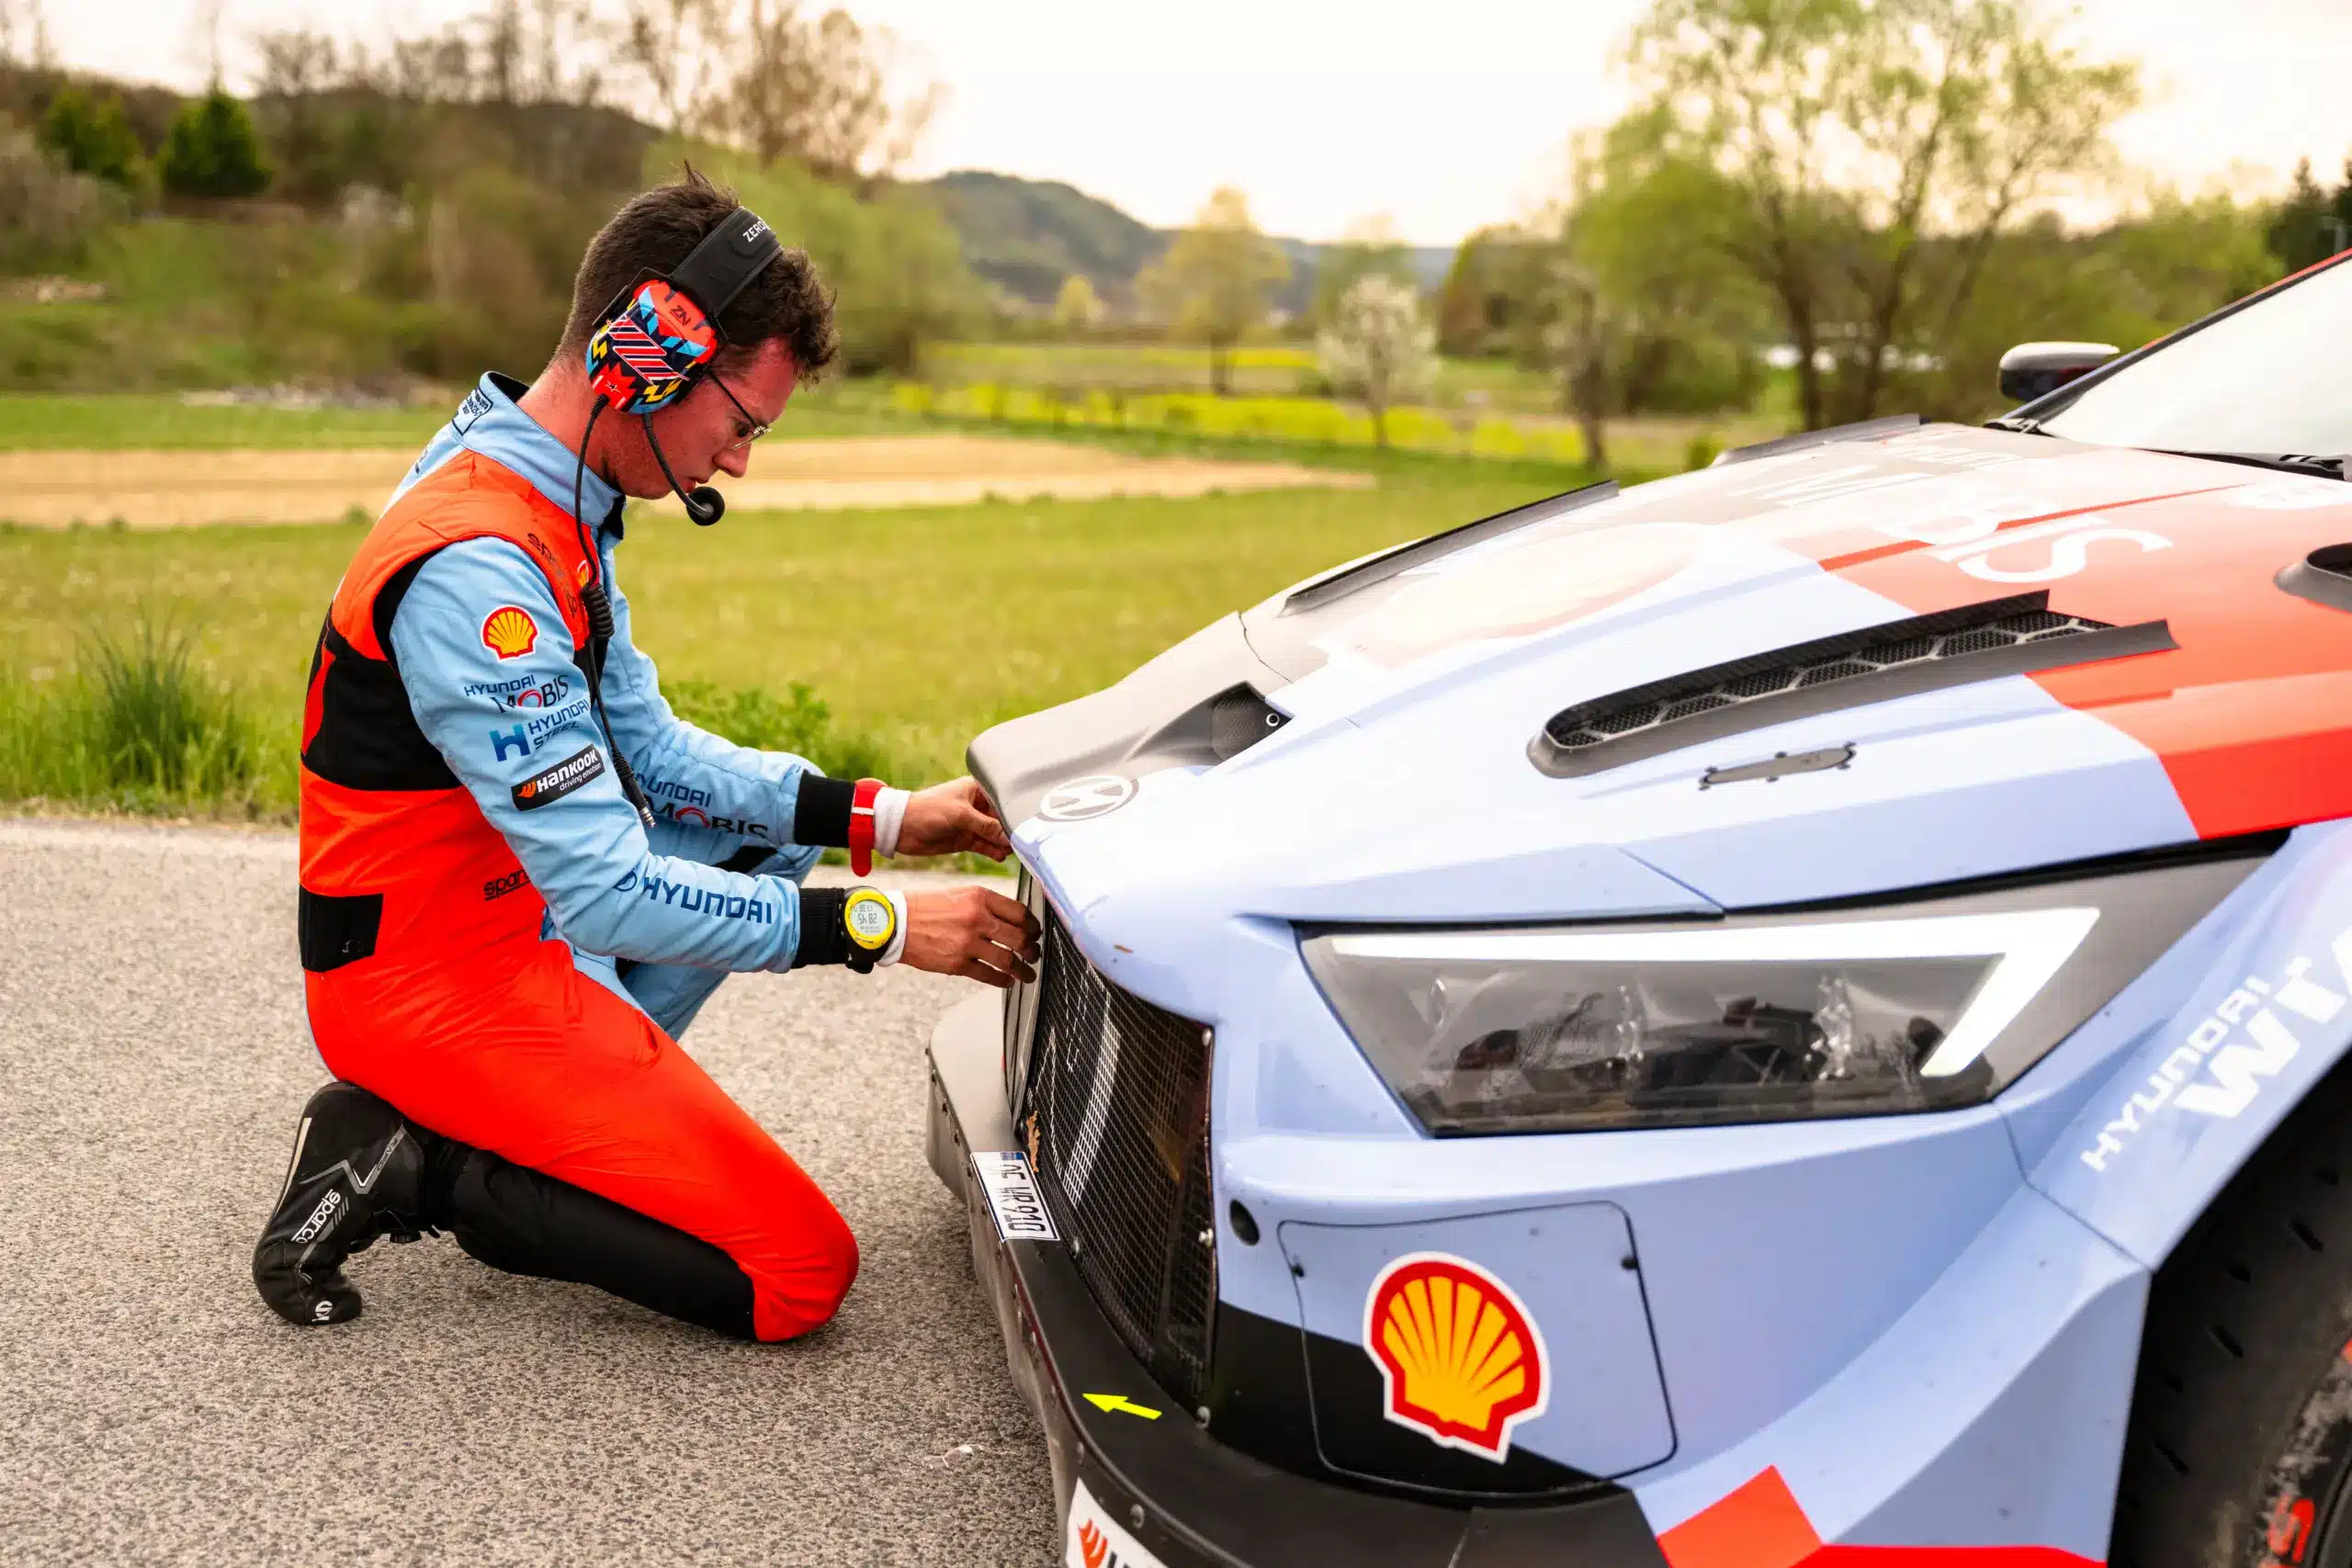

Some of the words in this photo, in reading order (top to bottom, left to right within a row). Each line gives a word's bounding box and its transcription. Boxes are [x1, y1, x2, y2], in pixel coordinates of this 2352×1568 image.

[742, 220, 768, 243] ZERO
[464, 674, 537, 697] HYUNDAI
[528, 699, 589, 735] HYUNDAI
[533, 720, 582, 750] STEEL
[560, 773, 583, 791] driving
[582, 763, 602, 780] emotion
[483, 868, 531, 901] spar
[643, 876, 772, 925] HYUNDAI
[2080, 975, 2271, 1172] HYUNDAI
[290, 1189, 342, 1245] sparco
